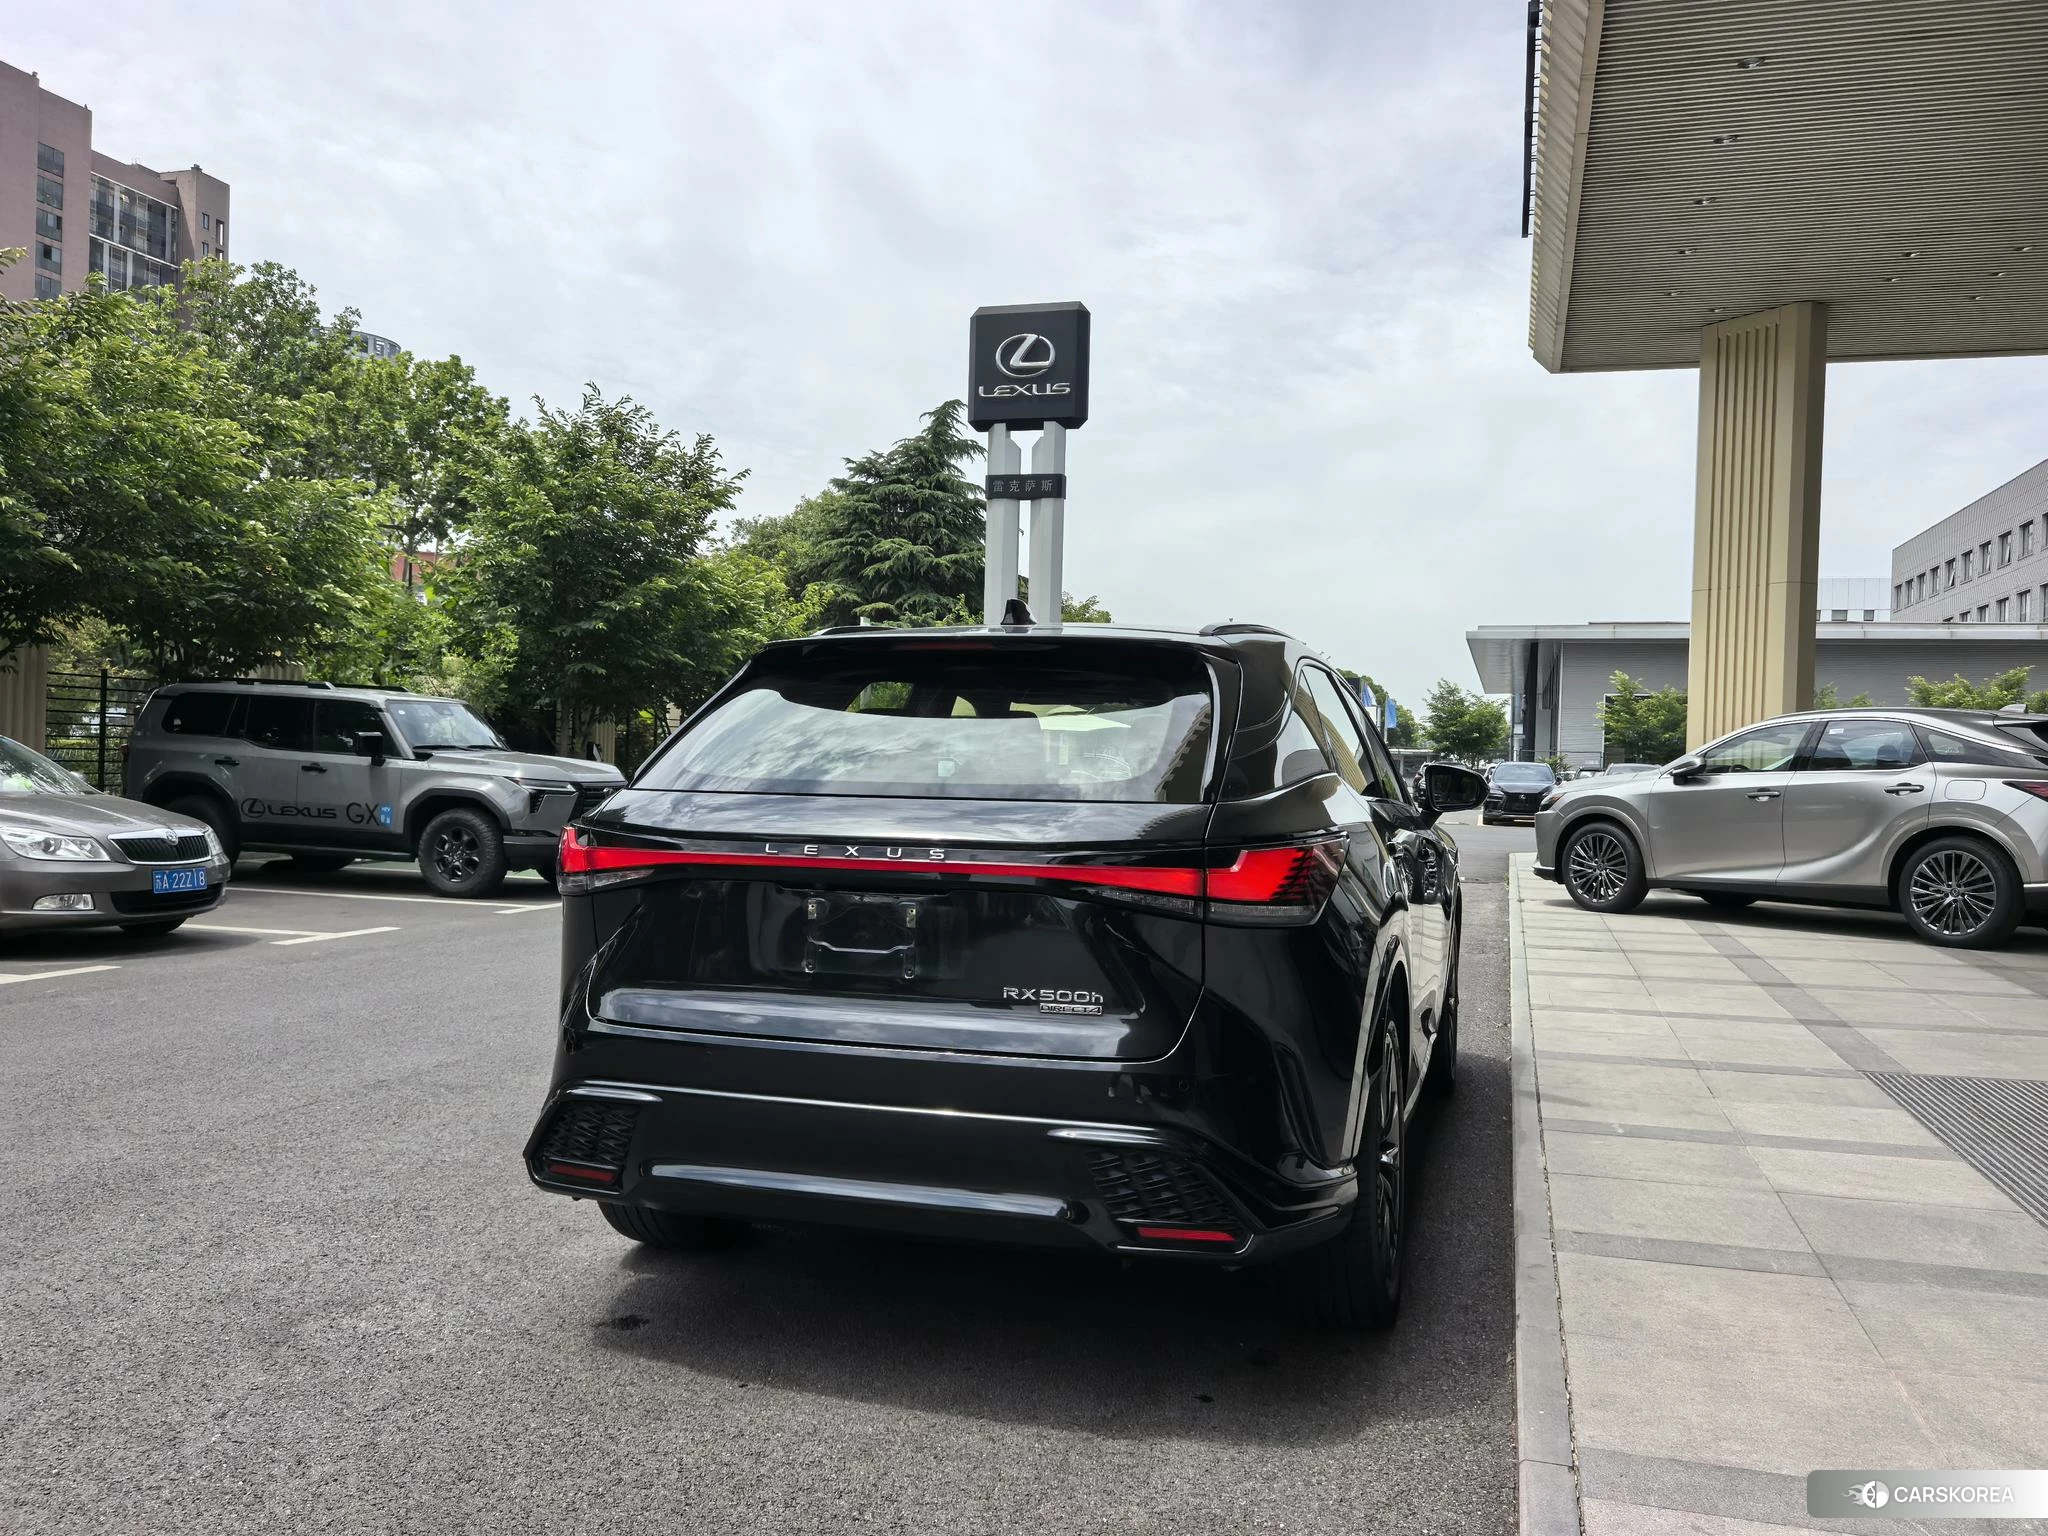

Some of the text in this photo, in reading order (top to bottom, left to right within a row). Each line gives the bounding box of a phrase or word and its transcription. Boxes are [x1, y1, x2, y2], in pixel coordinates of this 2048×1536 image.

[979, 382, 1071, 397] LEXUS
[993, 480, 1053, 493] 雷克萨斯
[267, 804, 336, 819] LEXUS
[346, 802, 380, 826] GX
[765, 843, 945, 859] LEXUS
